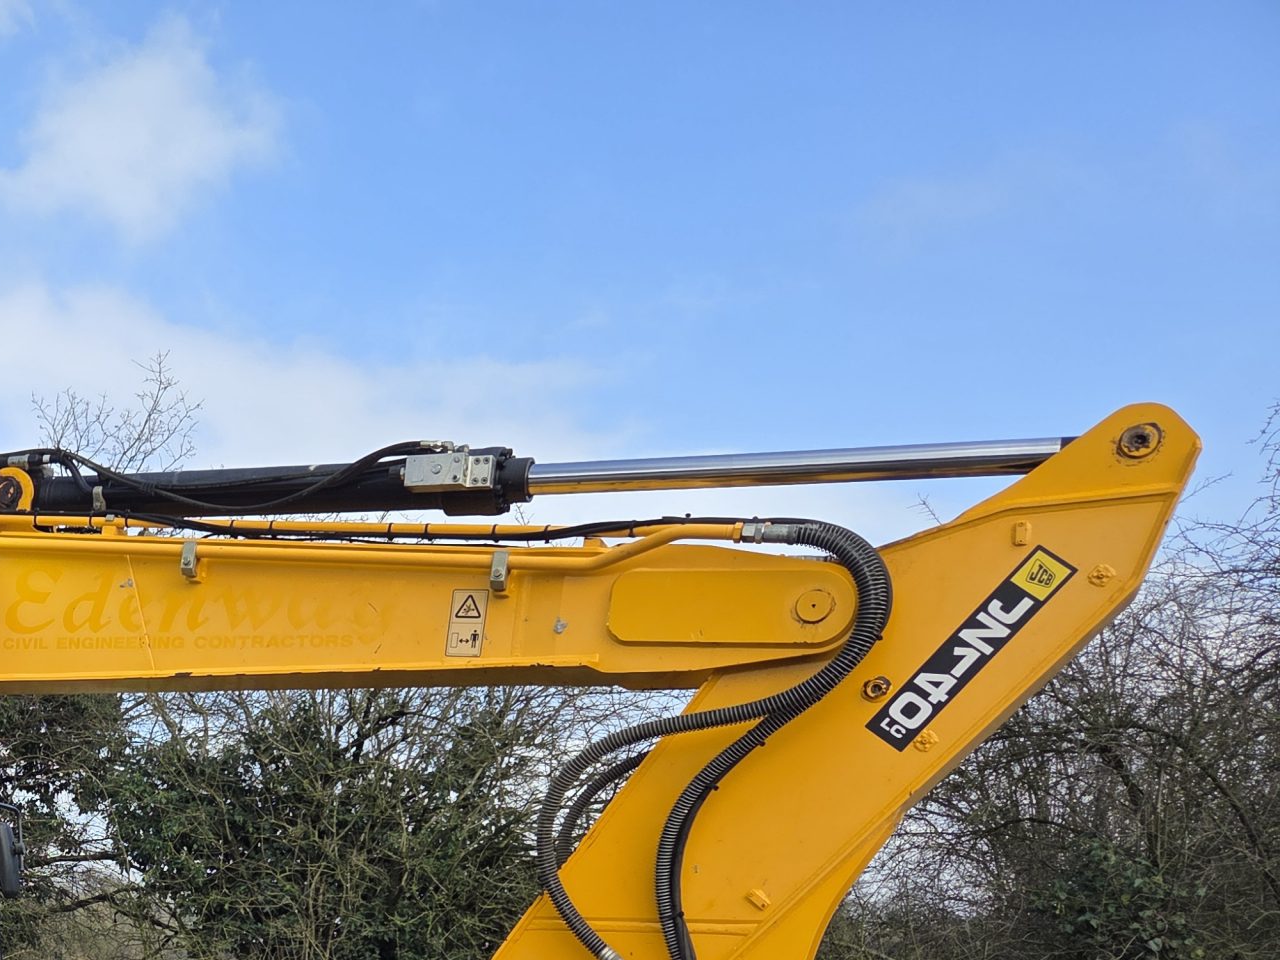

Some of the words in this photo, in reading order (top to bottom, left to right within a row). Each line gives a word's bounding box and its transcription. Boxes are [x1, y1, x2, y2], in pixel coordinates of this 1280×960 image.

[1029, 563, 1053, 586] JCB
[3, 567, 397, 645] Edenway
[3, 636, 48, 650] CIVIL
[56, 635, 185, 650] ENGINEERING
[193, 634, 354, 649] CONTRACTORS
